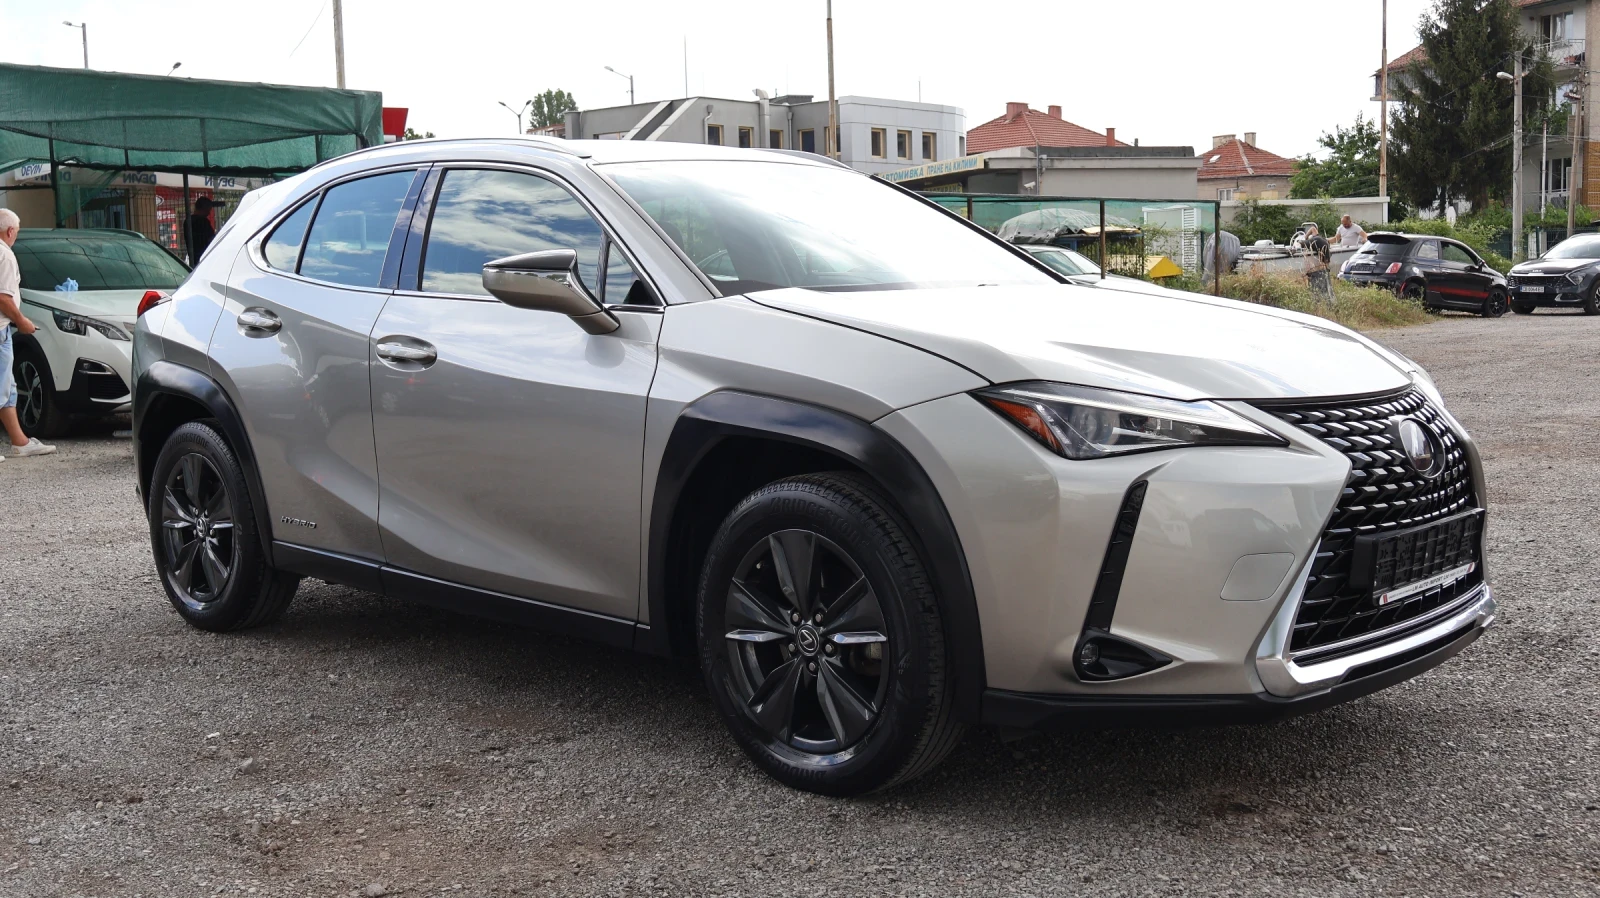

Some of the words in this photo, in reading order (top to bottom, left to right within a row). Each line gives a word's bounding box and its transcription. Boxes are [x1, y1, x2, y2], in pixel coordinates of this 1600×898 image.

[21, 164, 43, 177] DEVIN
[927, 163, 944, 175] ПРАНЕ
[945, 162, 952, 172] НА
[953, 158, 977, 170] КИЛИМИ
[281, 515, 317, 529] HYBRID
